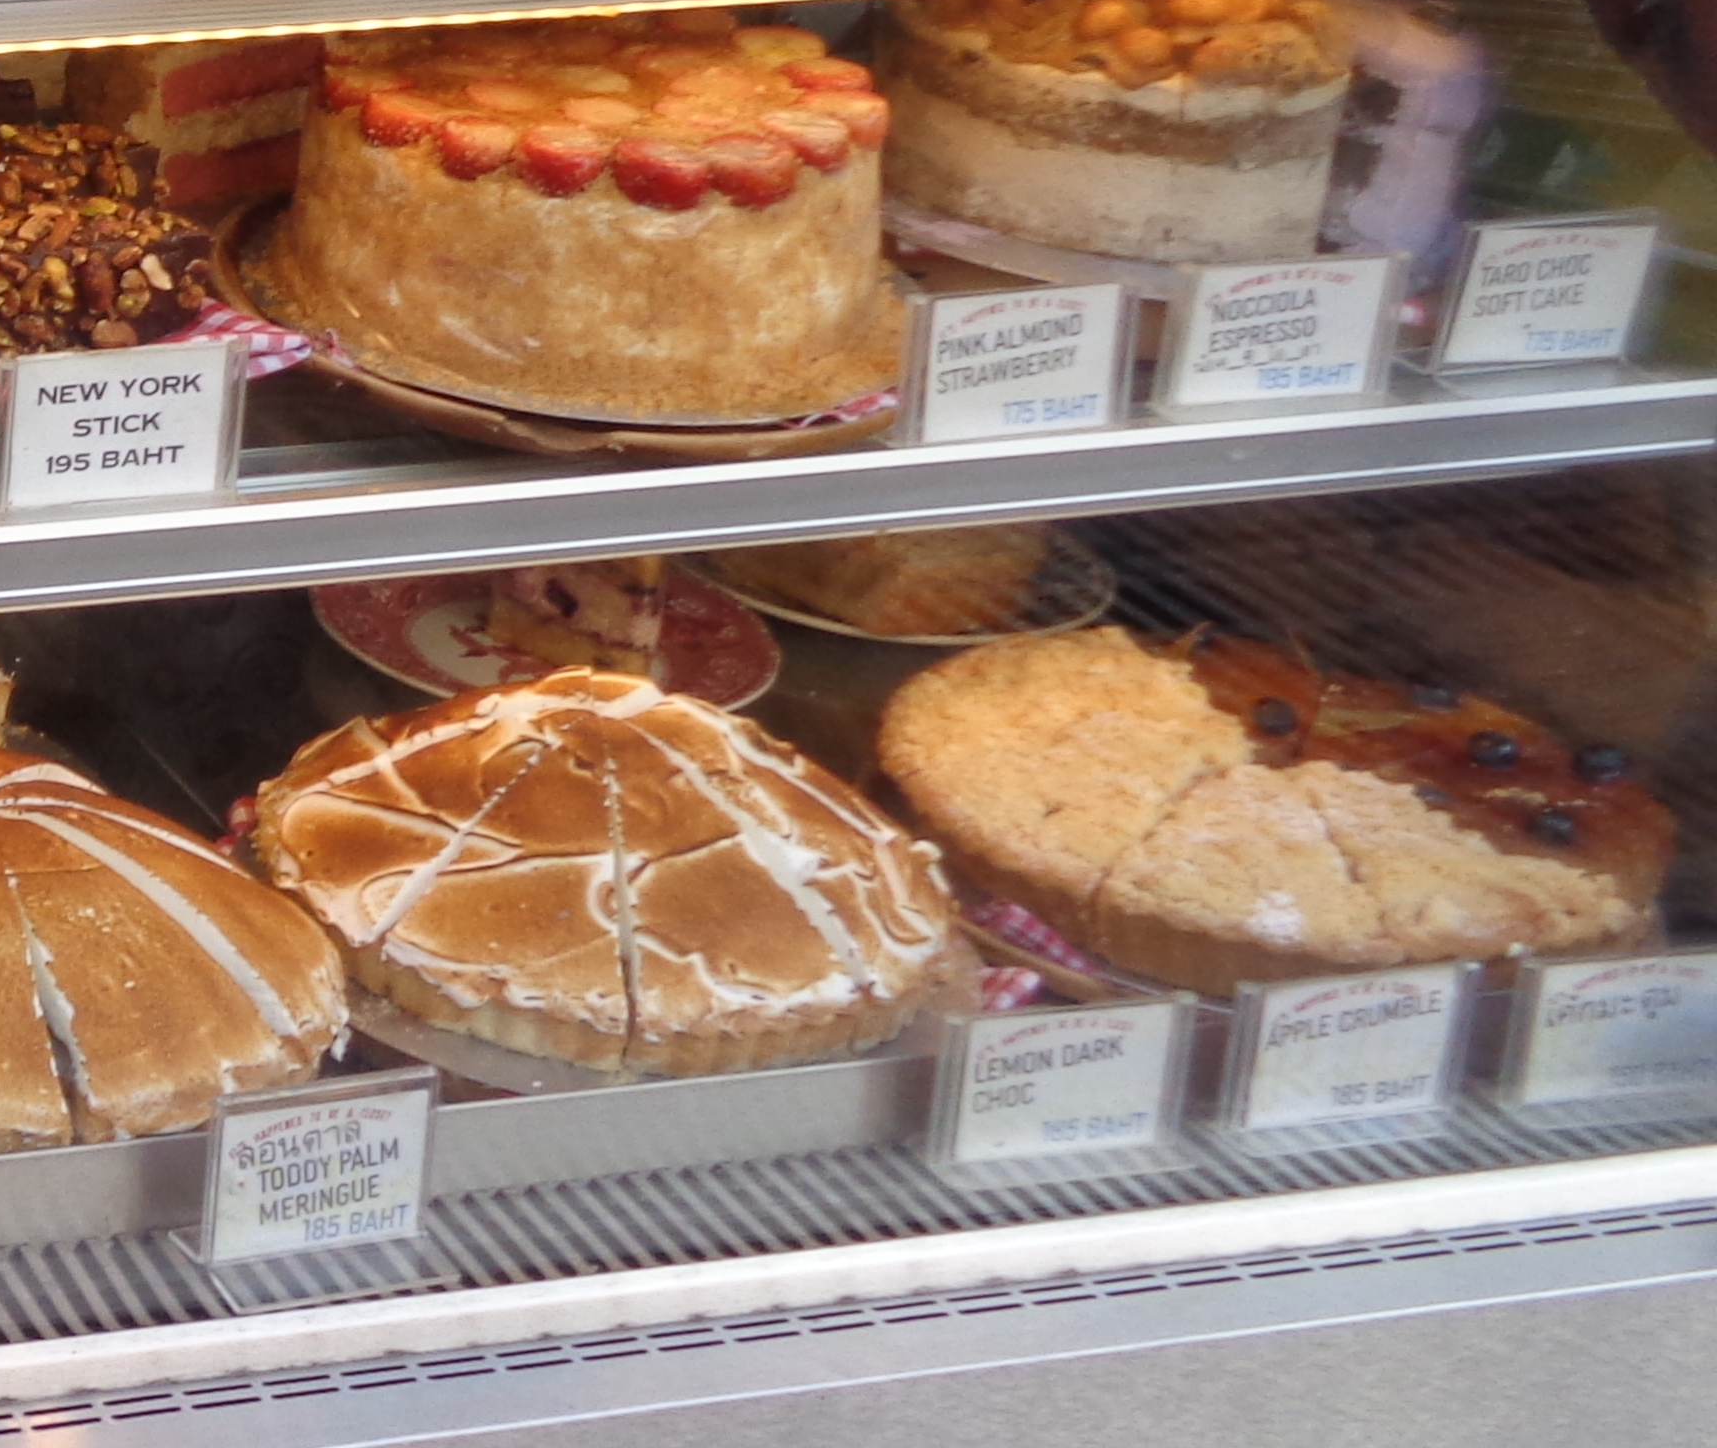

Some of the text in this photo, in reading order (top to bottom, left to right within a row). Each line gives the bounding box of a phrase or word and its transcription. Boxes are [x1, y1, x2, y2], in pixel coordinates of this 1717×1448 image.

[1481, 254, 1592, 287] TARO CHOC
[1474, 283, 1585, 318] SOFT CAKE
[937, 333, 987, 364] PINK
[994, 313, 1082, 352] ALMOND
[1209, 316, 1315, 353] ESPRESSO
[1562, 328, 1618, 351] BAHT
[937, 346, 1077, 394] STRAWBERRY
[1298, 363, 1354, 387] BAHT
[38, 374, 202, 406] NEW YORK
[1042, 394, 1101, 421] BAHT
[73, 412, 162, 437] STICK
[46, 445, 184, 474] 195 BAHT
[974, 1050, 1053, 1083] LEMON
[1062, 1035, 1124, 1067] DARK
[973, 1083, 1035, 1113] CHOC
[1087, 1112, 1149, 1139] BAHT
[257, 1138, 399, 1194] TODDY PALM
[260, 1175, 380, 1225] MERINGUE
[304, 1205, 409, 1241] 185 BAHT
